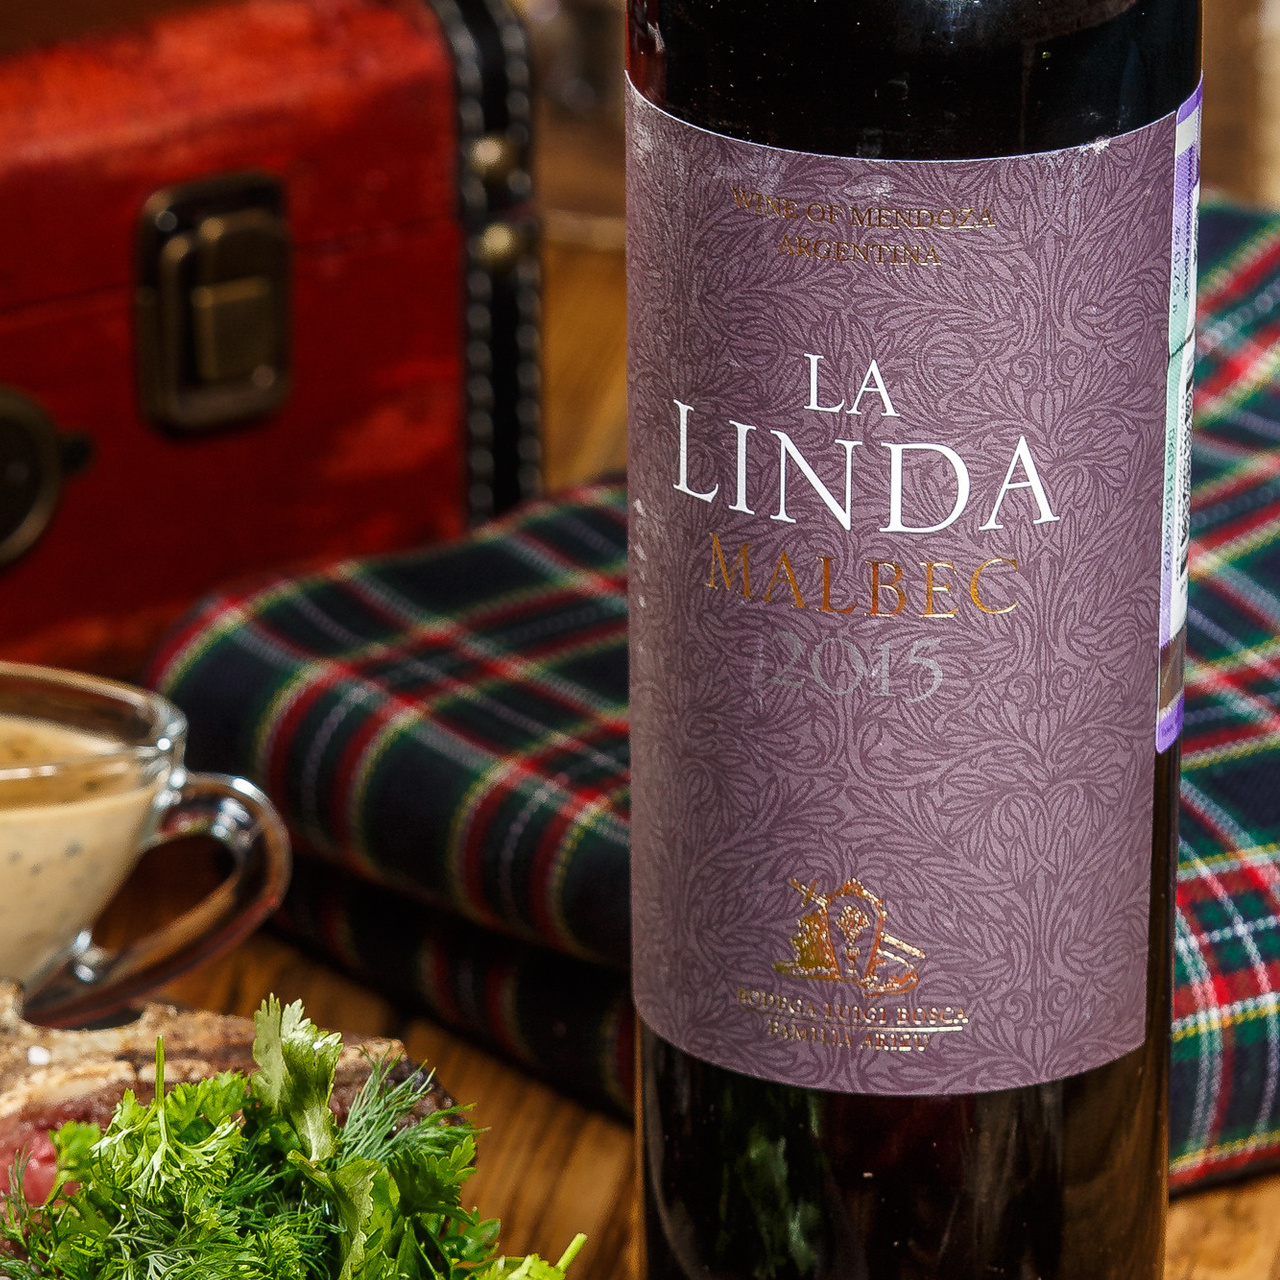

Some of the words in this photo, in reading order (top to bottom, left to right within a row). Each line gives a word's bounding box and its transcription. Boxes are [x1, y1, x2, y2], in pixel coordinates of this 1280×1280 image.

[730, 186, 799, 220] WINE
[805, 201, 844, 224] OF
[849, 205, 997, 230] MENDOZA
[777, 233, 942, 266] ARGENTINA
[803, 353, 900, 417] LA
[673, 399, 1060, 534] LINDA
[705, 532, 1021, 618] MALBEC
[768, 630, 944, 704] 2015
[736, 986, 818, 1018] BODEGA
[825, 1003, 888, 1025] LUIGI
[897, 1006, 969, 1025] BOSCA
[770, 1020, 854, 1049] FAMILIA
[859, 1032, 931, 1052] ARIZU
